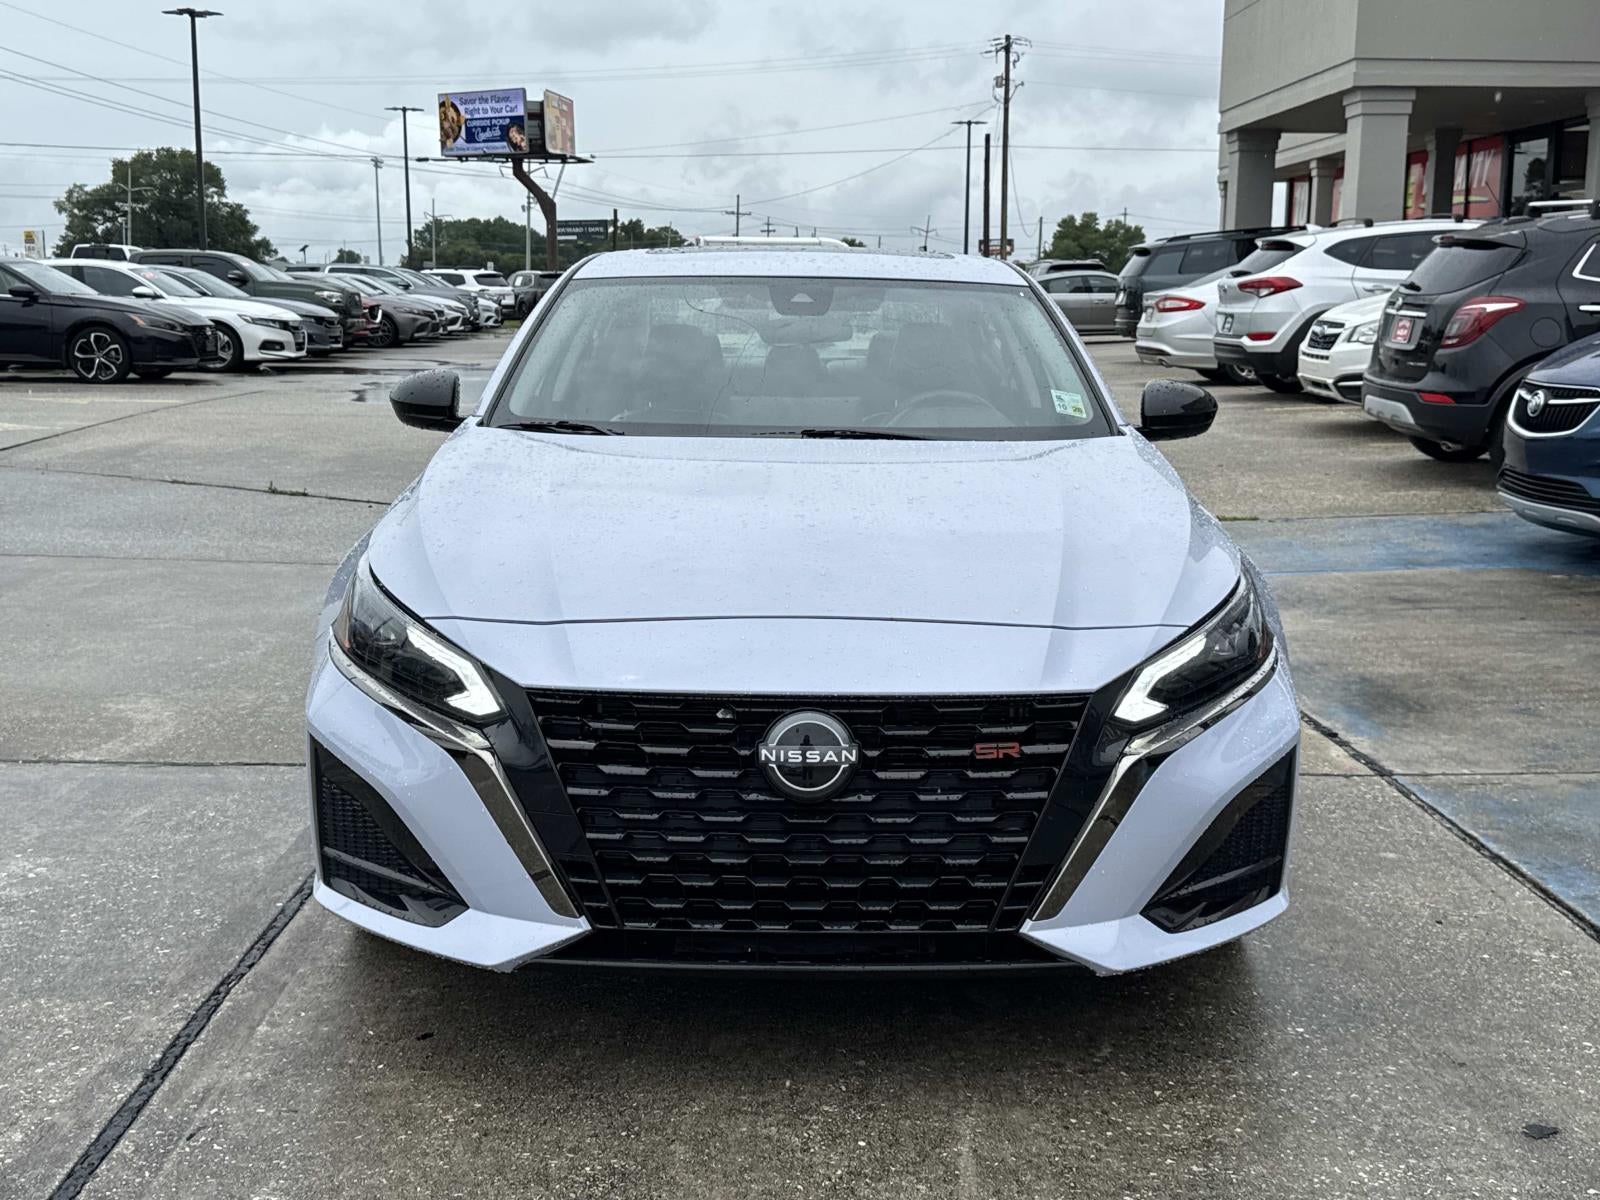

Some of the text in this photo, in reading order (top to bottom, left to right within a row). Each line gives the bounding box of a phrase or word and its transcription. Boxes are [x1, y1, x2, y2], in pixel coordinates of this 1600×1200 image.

[459, 96, 477, 105] Savor
[478, 95, 489, 104] the
[464, 104, 518, 117] Right to Your Car!
[492, 117, 510, 126] PICKUP
[760, 748, 857, 763] NISSAN
[975, 742, 1021, 759] SR
